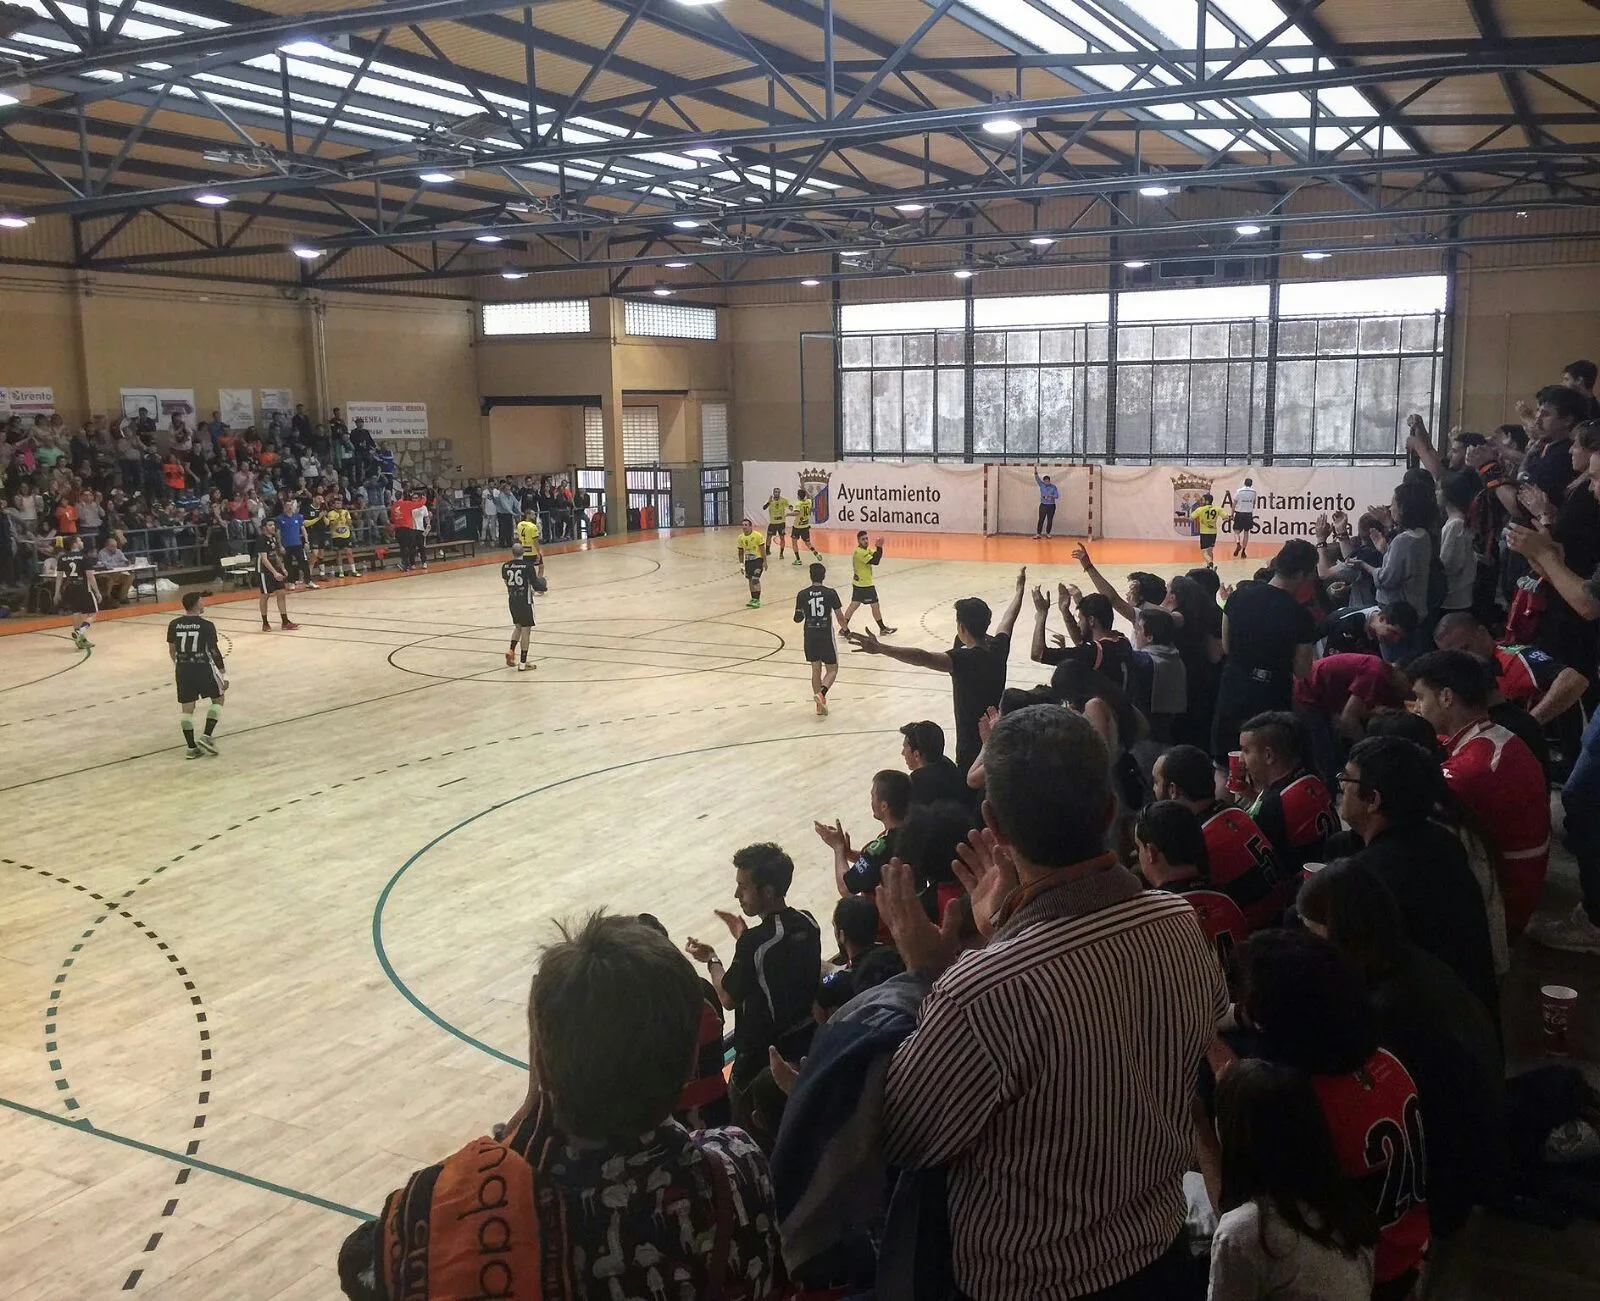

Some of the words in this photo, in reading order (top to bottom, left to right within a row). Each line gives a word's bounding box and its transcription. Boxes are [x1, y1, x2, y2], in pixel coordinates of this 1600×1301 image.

[837, 483, 941, 504] Ayuntamiento
[1221, 490, 1356, 512] Antamiento
[838, 506, 855, 522] de
[860, 506, 940, 525] Salamanca
[1205, 509, 1217, 520] 19
[521, 528, 526, 541] 4
[1249, 515, 1353, 536] Salamaa
[69, 562, 79, 577] 2
[506, 569, 524, 586] 26
[808, 597, 825, 617] 15
[176, 631, 199, 653] 77
